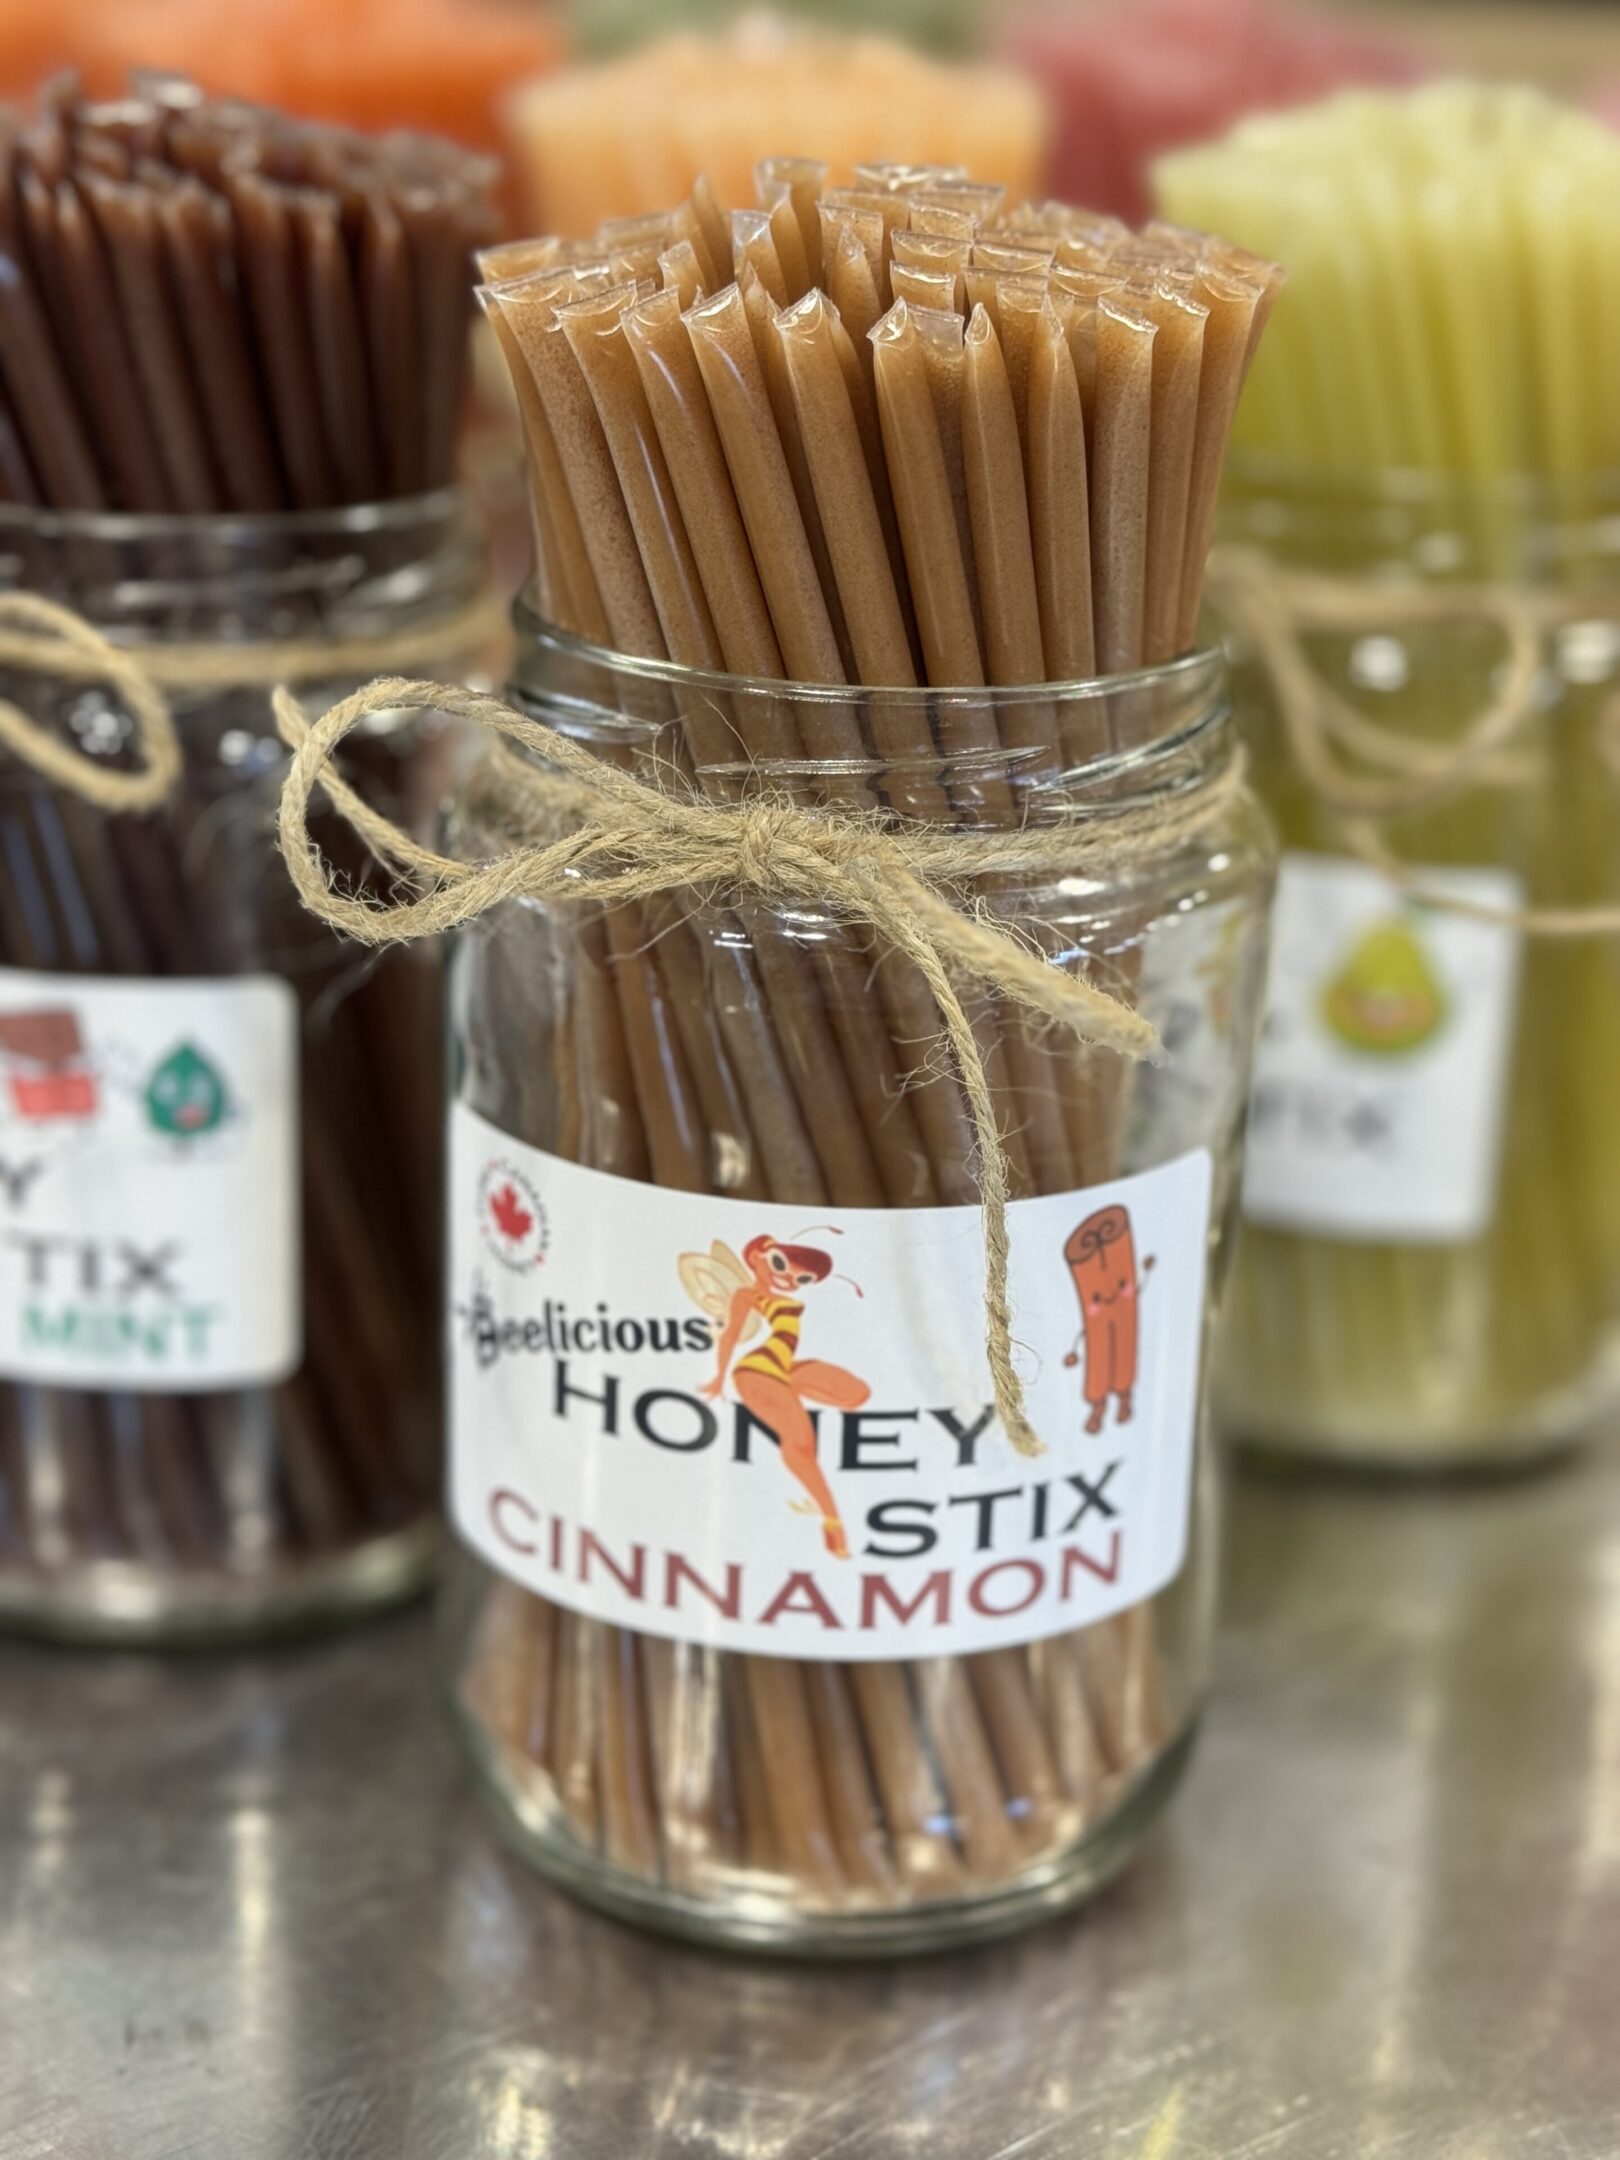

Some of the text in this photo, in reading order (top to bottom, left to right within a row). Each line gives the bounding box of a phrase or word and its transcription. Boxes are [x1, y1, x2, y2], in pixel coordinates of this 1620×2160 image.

[551, 1358, 997, 1472] HONEY
[487, 1487, 1124, 1631] CINNAMON
[864, 1460, 1125, 1558] STIX
